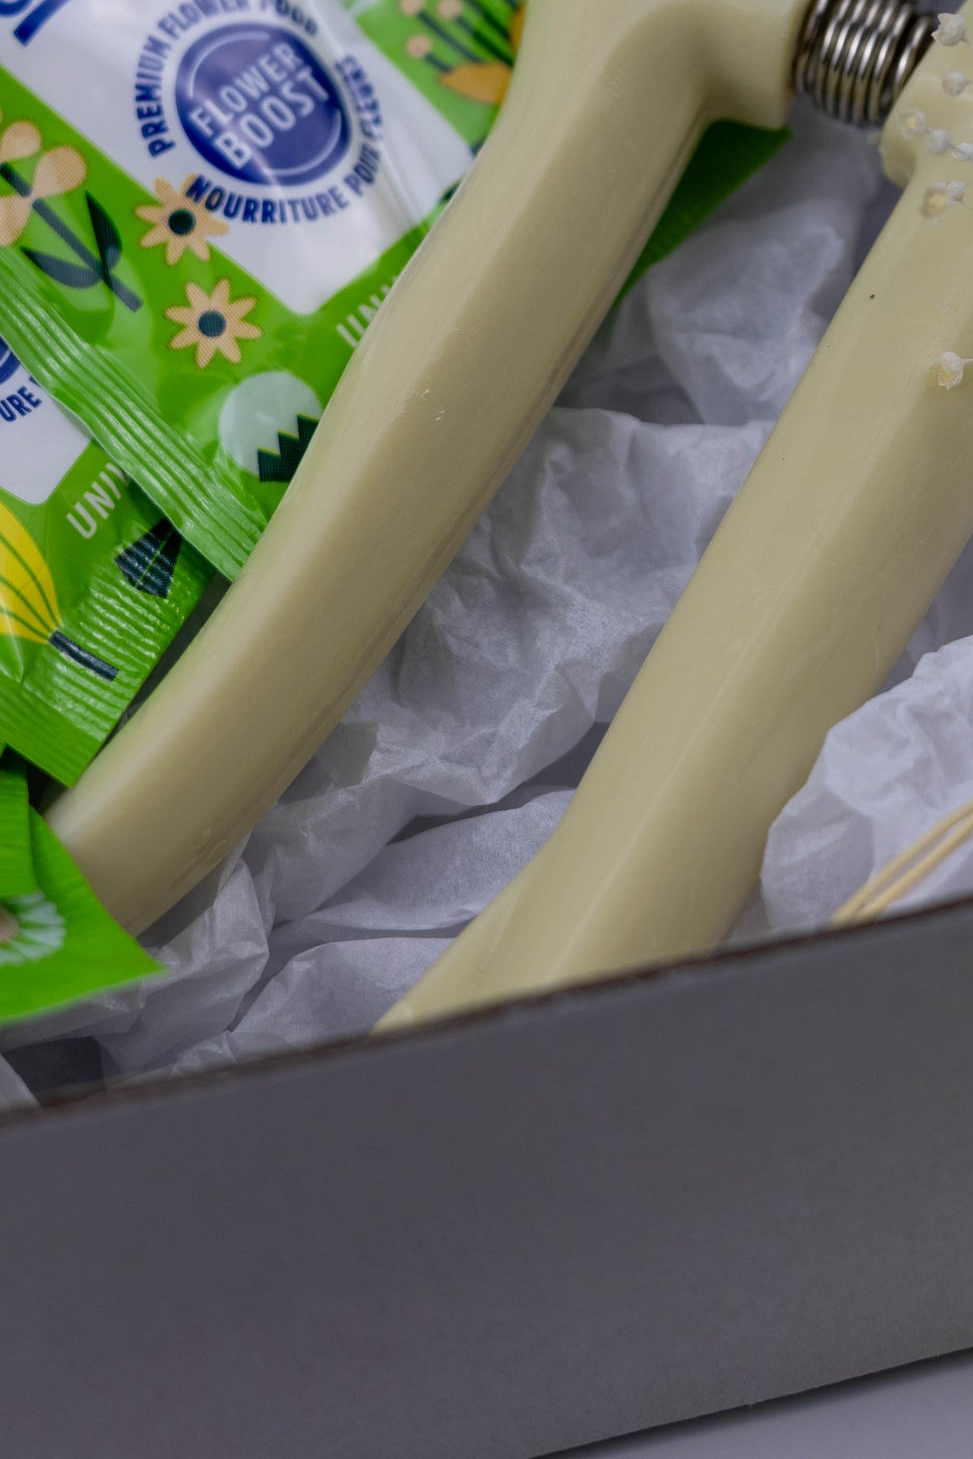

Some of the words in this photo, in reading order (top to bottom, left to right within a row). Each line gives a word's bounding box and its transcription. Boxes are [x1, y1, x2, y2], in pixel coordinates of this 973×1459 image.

[134, 36, 176, 158] PREMIUM
[189, 41, 304, 137] FLOWER
[214, 65, 329, 170] BOOST
[186, 174, 349, 224] NOURRITURE
